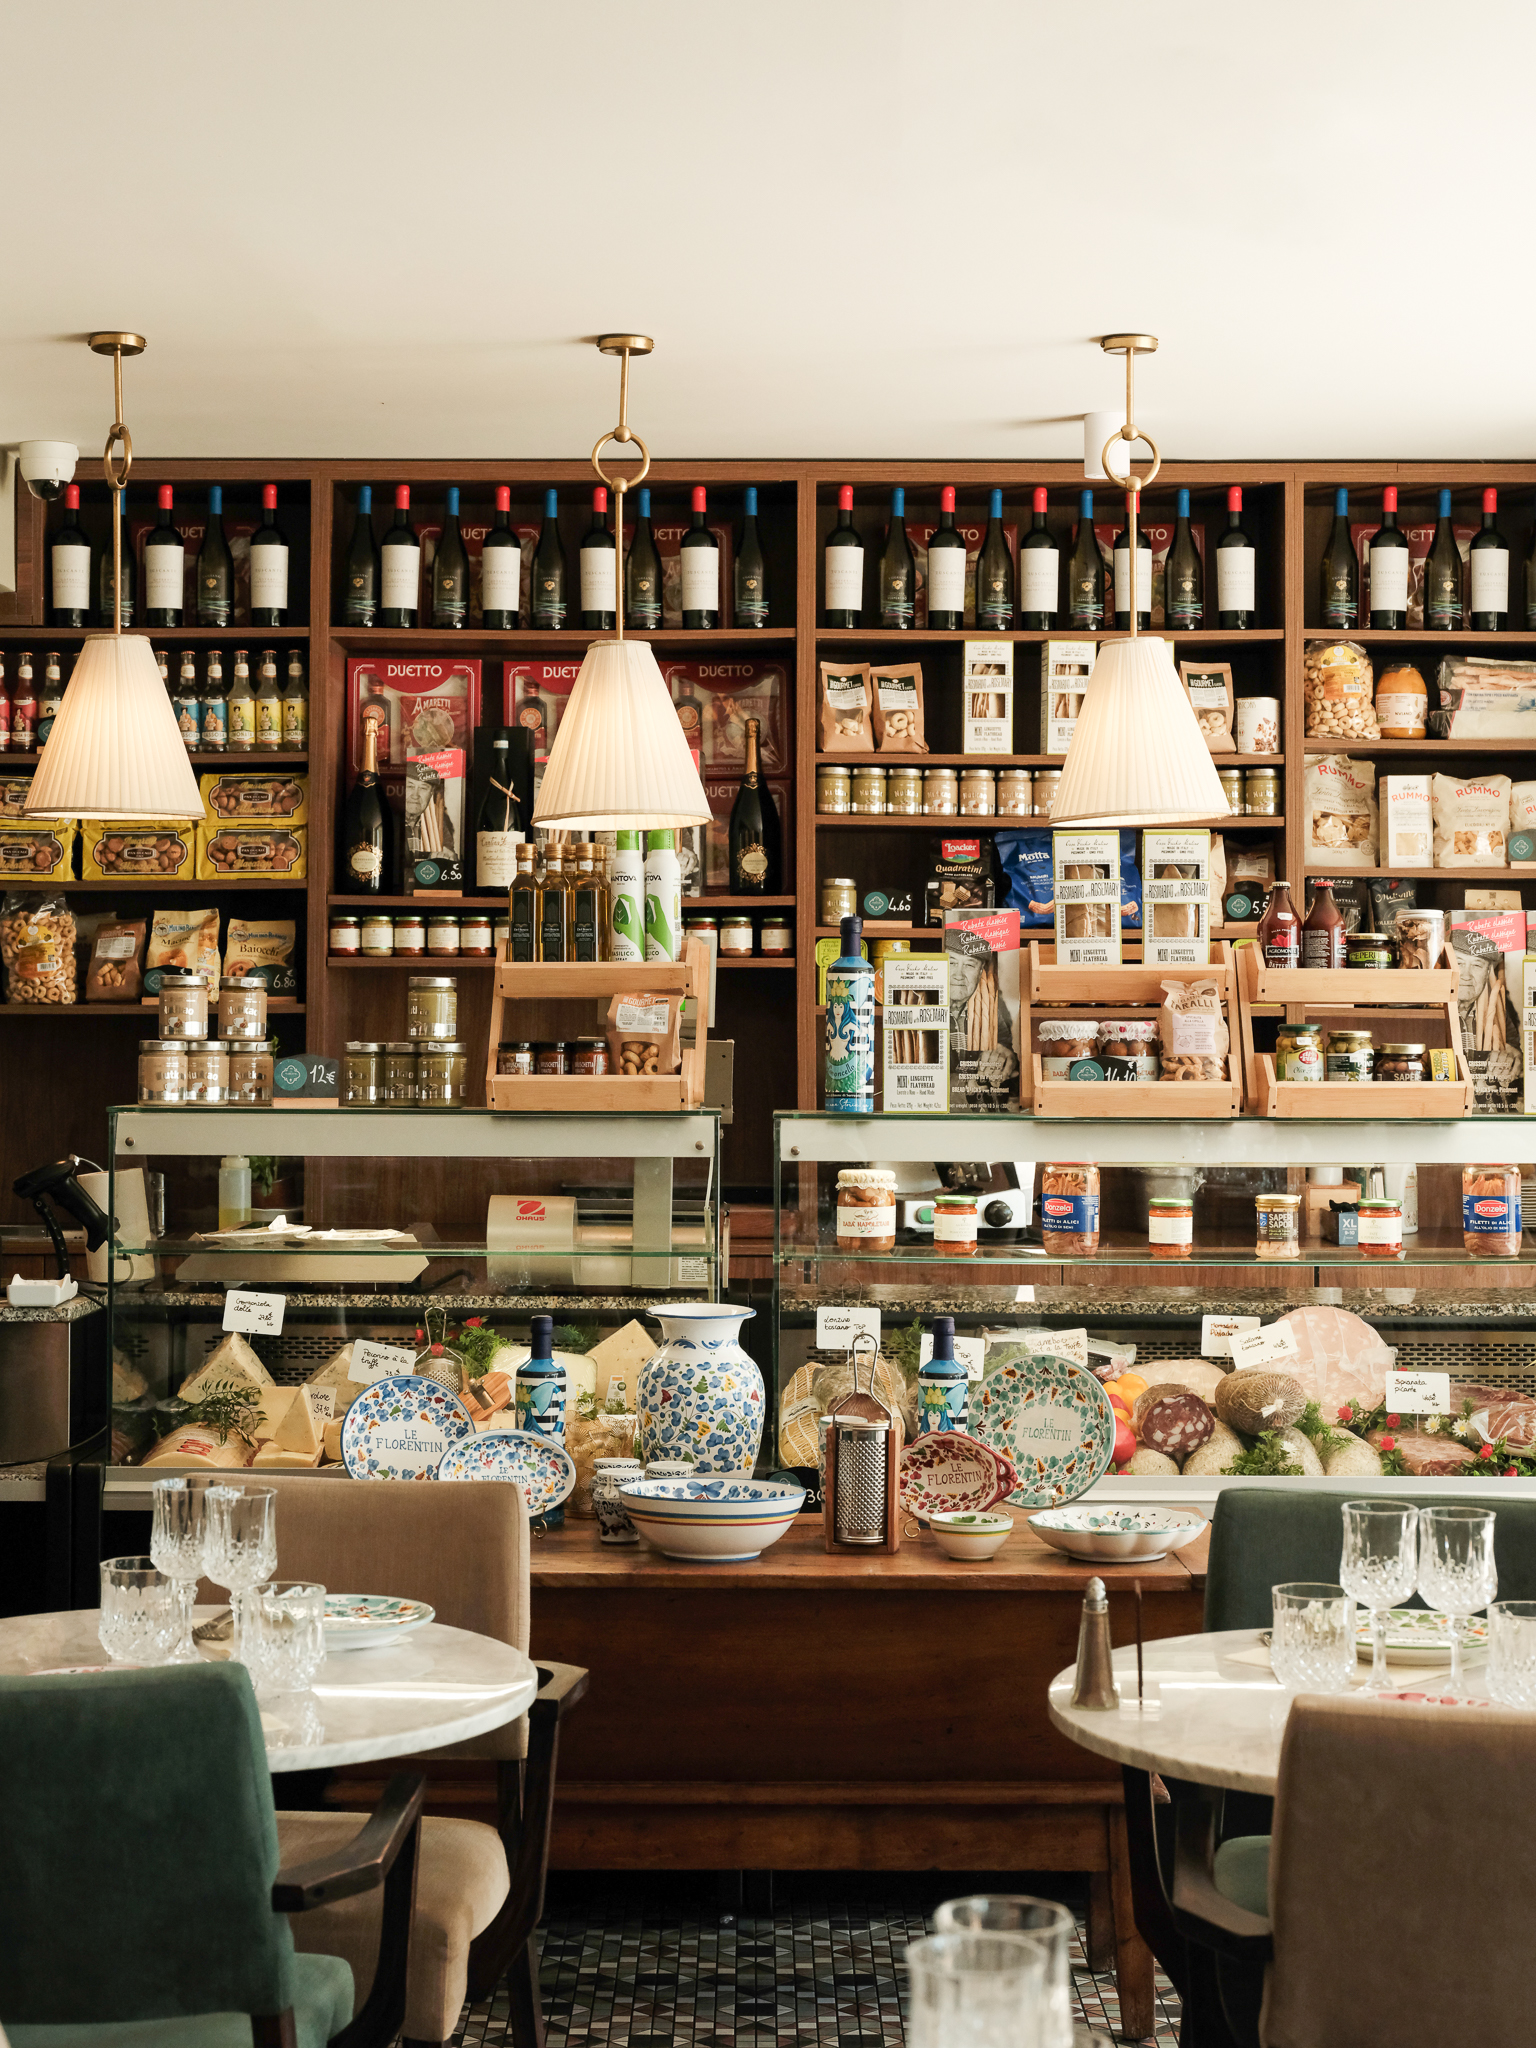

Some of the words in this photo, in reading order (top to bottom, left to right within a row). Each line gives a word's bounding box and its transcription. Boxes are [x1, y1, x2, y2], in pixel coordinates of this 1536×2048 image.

[180, 527, 206, 538] UET
[388, 664, 442, 677] DUETTO
[543, 666, 582, 678] DUET
[700, 665, 753, 677] DUETTO
[1318, 764, 1366, 788] RUMMO
[1392, 792, 1430, 802] RUMMO
[1455, 786, 1500, 798] RUMMO
[944, 843, 976, 852] Loacker
[1019, 852, 1050, 862] Motta
[441, 870, 462, 880] 6.90
[936, 864, 982, 874] Quadratini
[1060, 885, 1084, 899] ROSMARINO
[1090, 882, 1119, 897] ROSEMARY
[1148, 885, 1174, 899] ROSMARINO
[1180, 882, 1208, 897] ROSEMARY
[888, 897, 911, 911] 4.60
[1252, 900, 1269, 914] 5.5
[240, 944, 279, 956] Baiocchi
[1070, 950, 1080, 962] MINI
[1158, 949, 1168, 961] MINI
[273, 974, 296, 988] 6.80
[628, 998, 656, 1006] GOURMET
[1171, 1000, 1213, 1010] TARALLI
[888, 1011, 913, 1025] ROSMARINO
[920, 1009, 948, 1022] ROSEMARY
[310, 1064, 336, 1084] 12€
[897, 1076, 908, 1088] MINI
[1045, 1202, 1072, 1213] Donzela
[1342, 1218, 1357, 1228] XL
[363, 1348, 390, 1359] Pecorino
[1044, 1418, 1054, 1428] LE
[404, 1429, 417, 1440] LE
[1022, 1428, 1072, 1441] FLORENTIN
[376, 1438, 443, 1453] FLORENTIN
[499, 1466, 508, 1475] LE
[950, 1463, 964, 1472] LE
[482, 1475, 528, 1483] FLORENTIN
[927, 1471, 982, 1486] FLORENTIN
